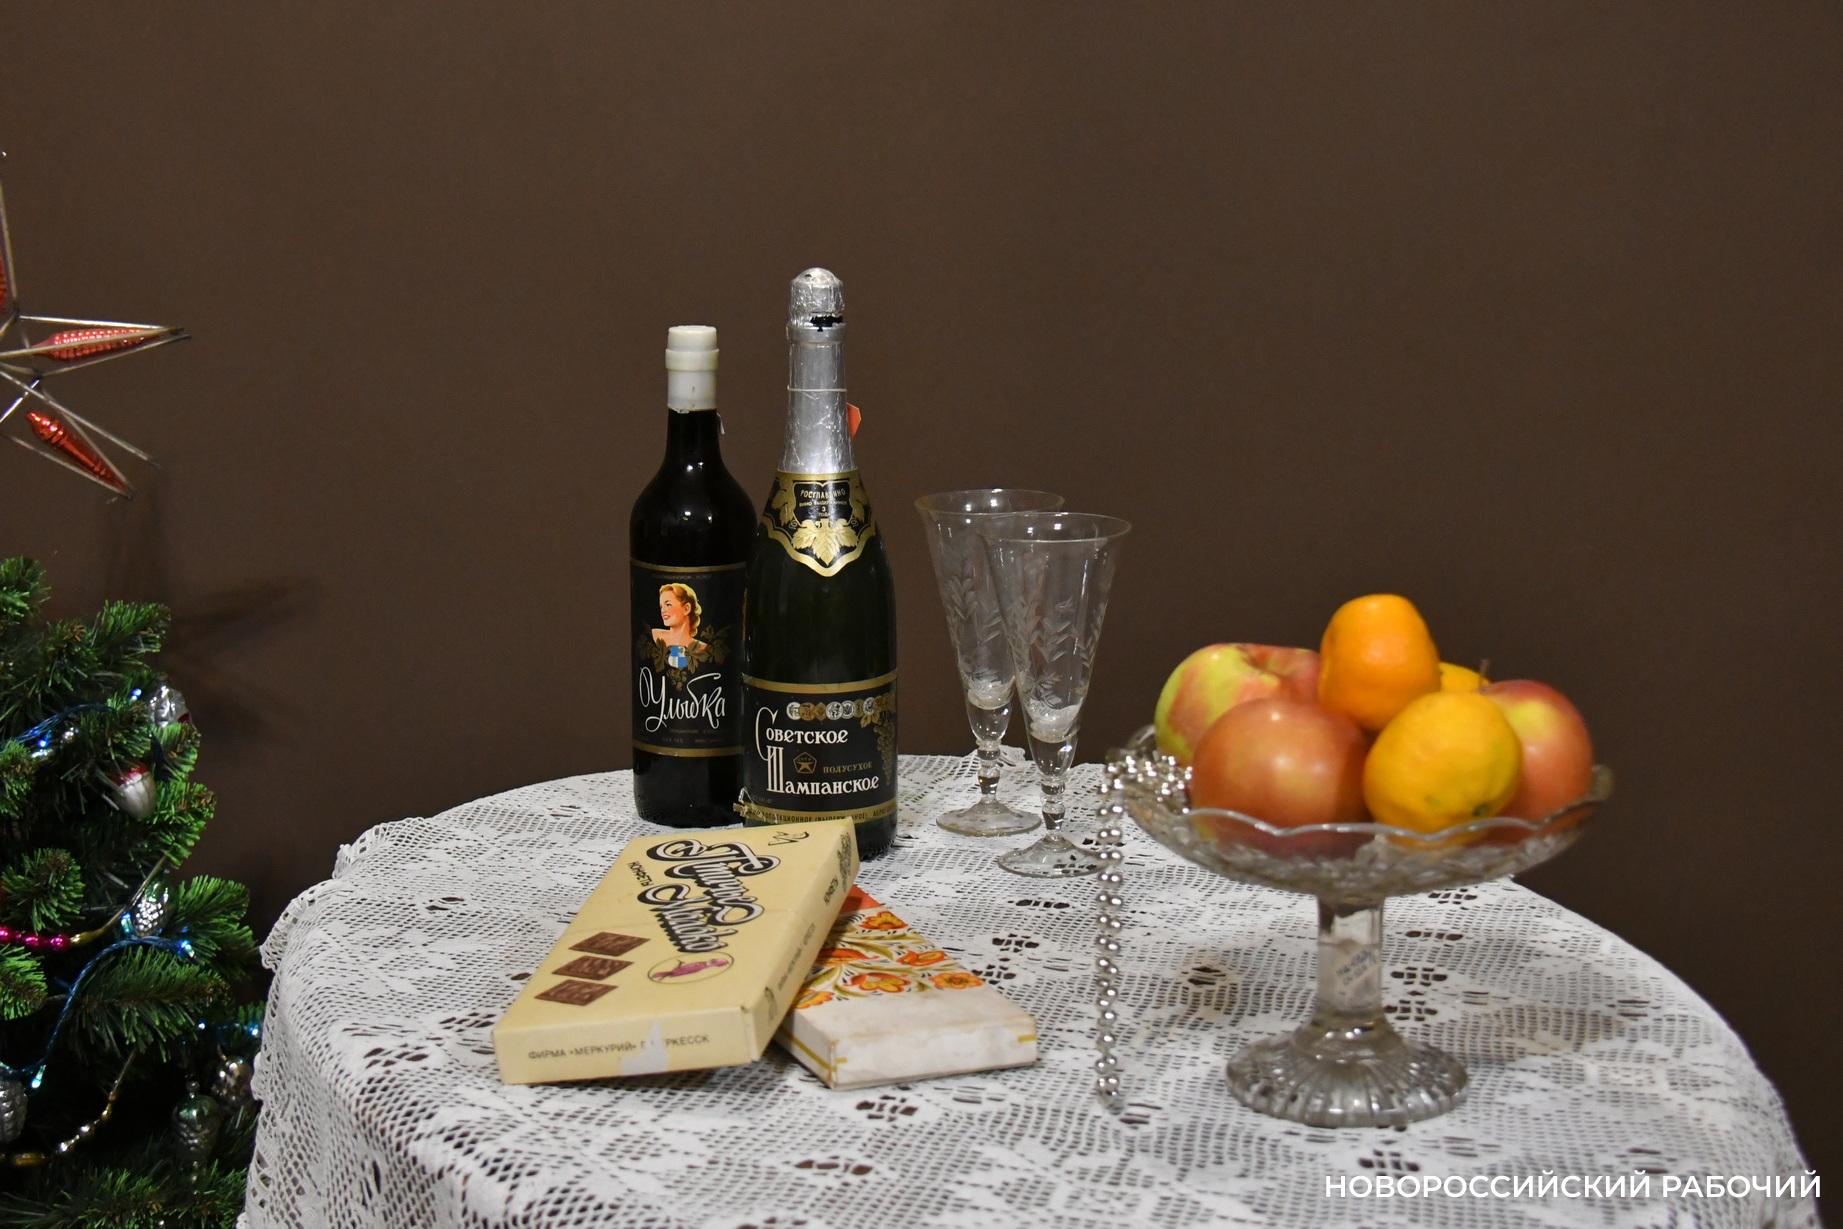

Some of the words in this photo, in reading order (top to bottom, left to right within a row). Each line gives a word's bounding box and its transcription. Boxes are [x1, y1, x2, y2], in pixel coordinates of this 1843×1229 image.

[640, 666, 726, 732] Улыбка
[755, 706, 849, 761] Советское
[766, 745, 880, 796] Шампанское
[528, 1050, 567, 1060] ФИРМА
[650, 1034, 710, 1047] РКЕССК
